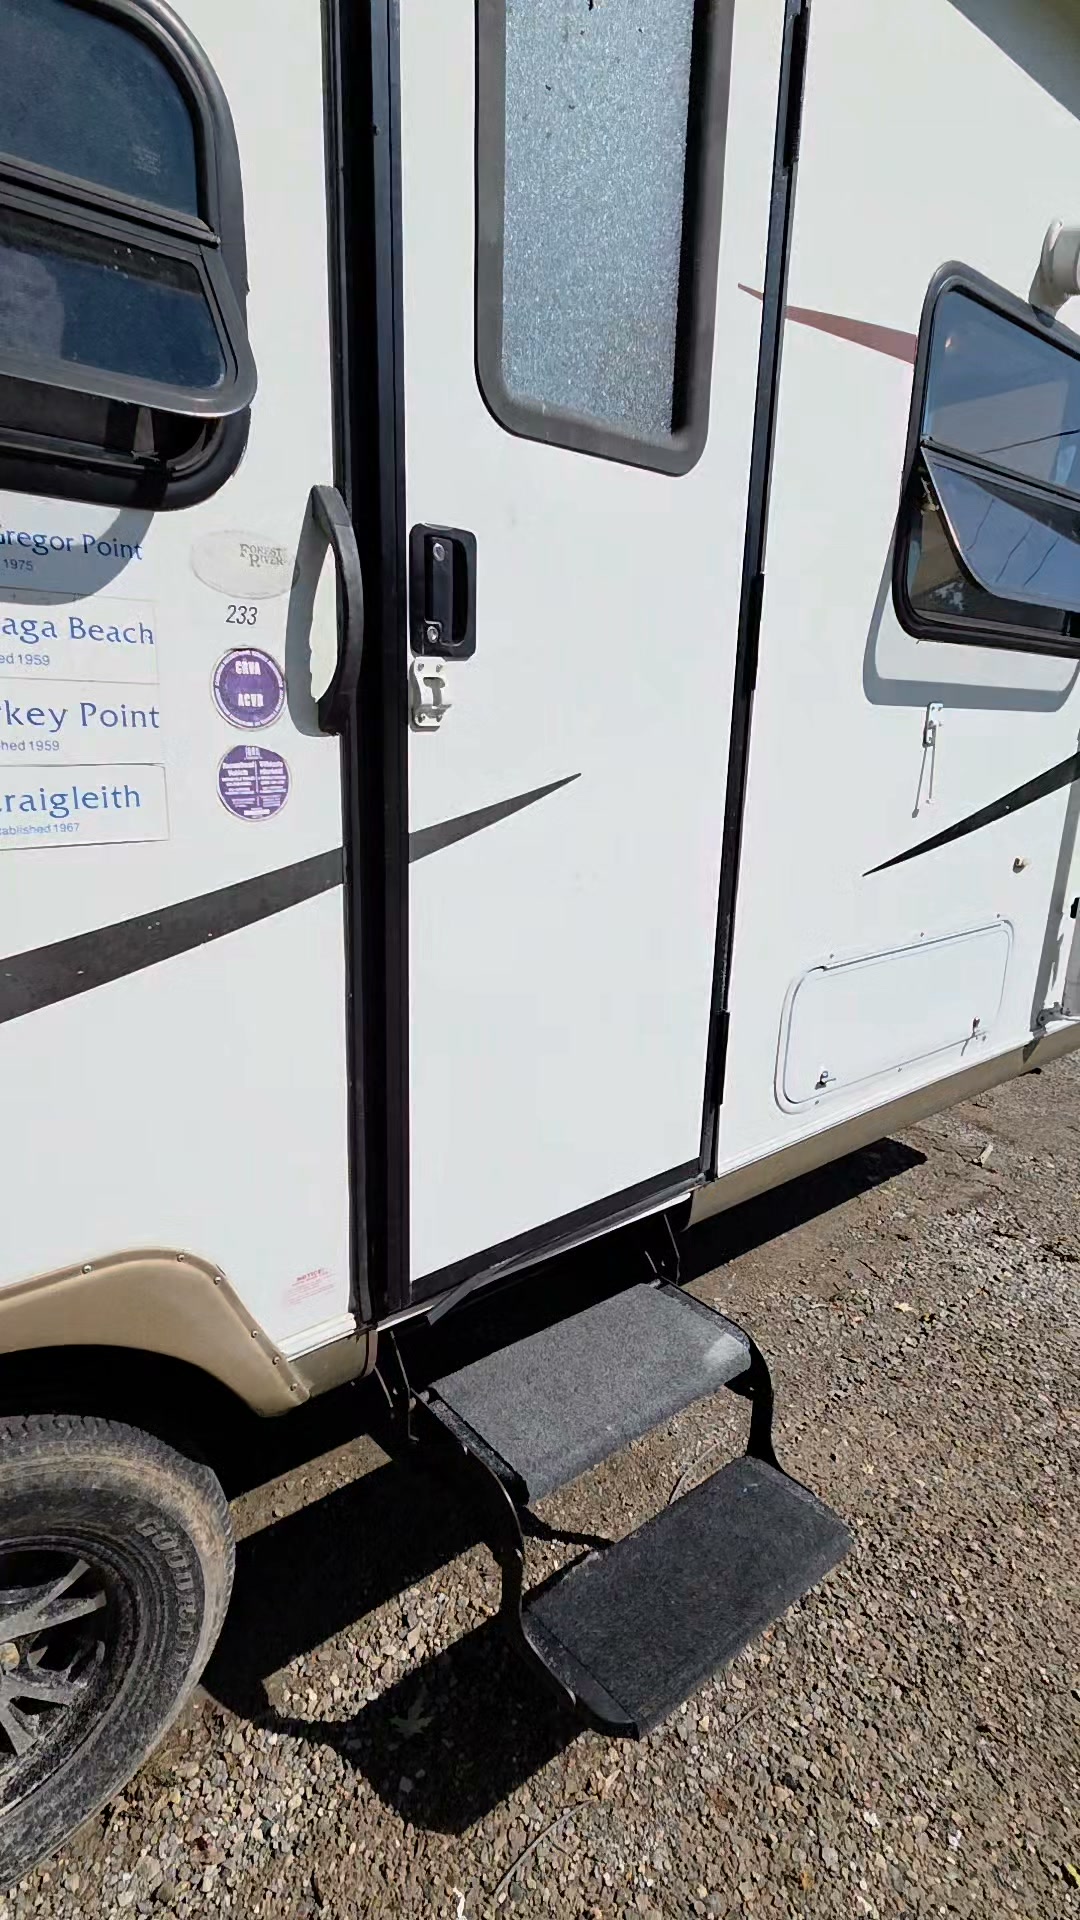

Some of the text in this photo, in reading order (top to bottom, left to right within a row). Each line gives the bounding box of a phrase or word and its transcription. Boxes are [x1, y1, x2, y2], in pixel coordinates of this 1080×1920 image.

[82, 534, 142, 560] Point
[239, 543, 284, 557] FOREST
[3, 558, 33, 571] 1975
[249, 553, 284, 568] RIVER
[225, 604, 258, 625] 233
[69, 616, 154, 644] Beach
[18, 653, 50, 666] 1959
[0, 700, 160, 733] key Point
[29, 740, 60, 751] 1959
[0, 785, 141, 819] raigleith
[54, 822, 80, 833] 1967
